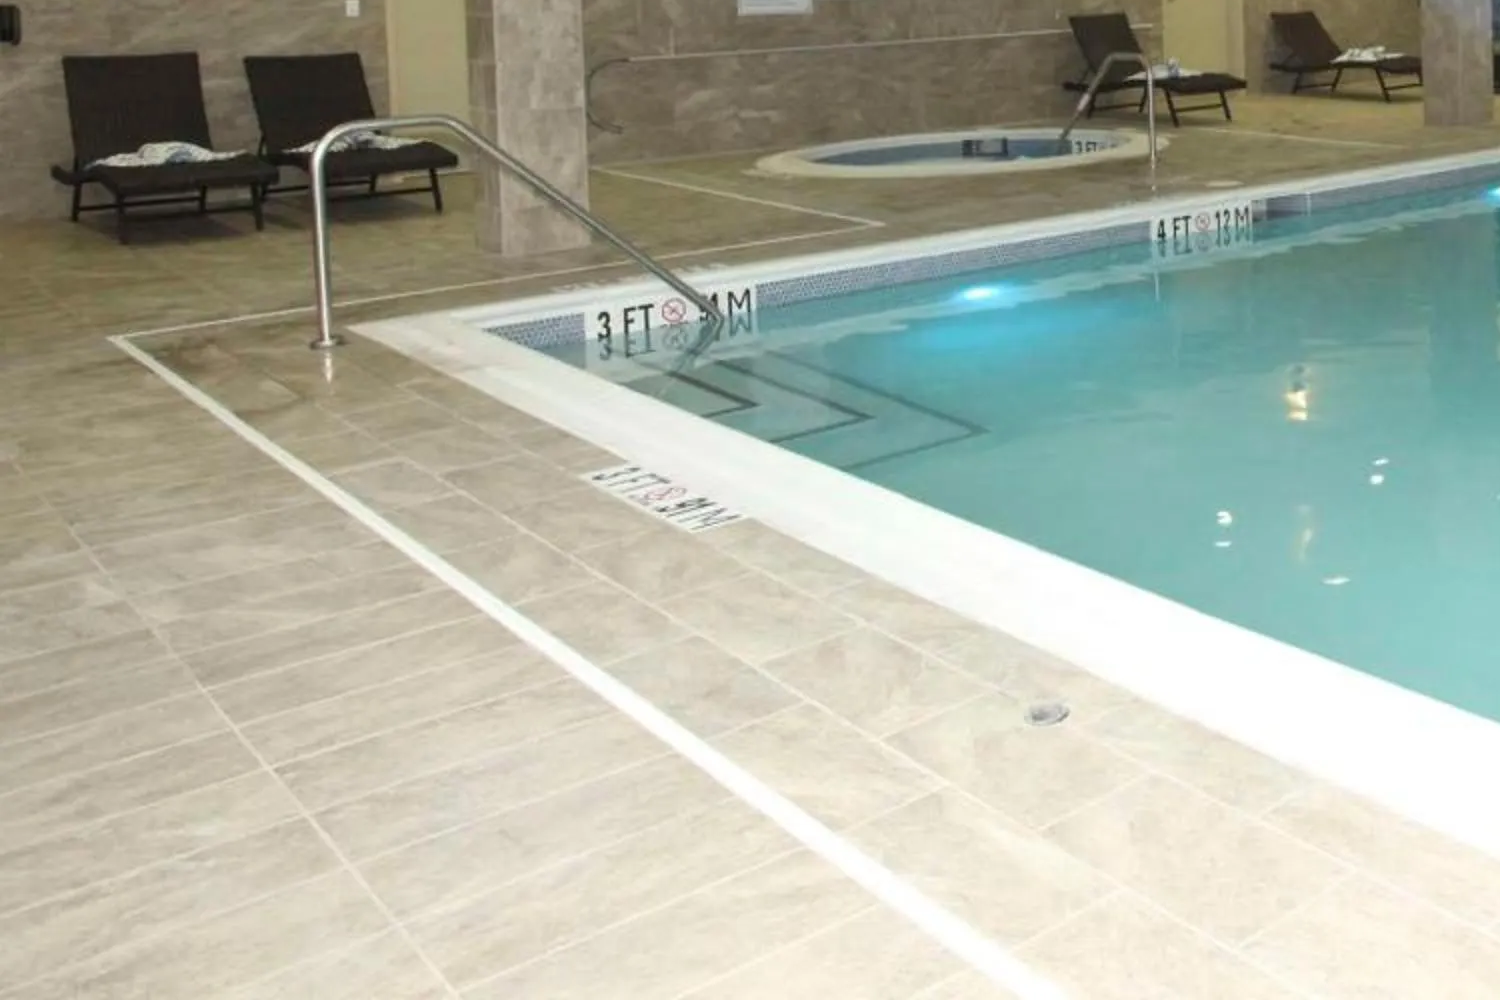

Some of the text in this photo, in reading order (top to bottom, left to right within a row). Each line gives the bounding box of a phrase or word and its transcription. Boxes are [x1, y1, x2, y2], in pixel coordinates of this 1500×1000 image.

[1157, 219, 1167, 239] 4
[1173, 215, 1192, 238] FT
[597, 311, 612, 340] 3
[624, 303, 655, 336] FT
[591, 466, 642, 481] 3
[607, 472, 673, 494] FT
